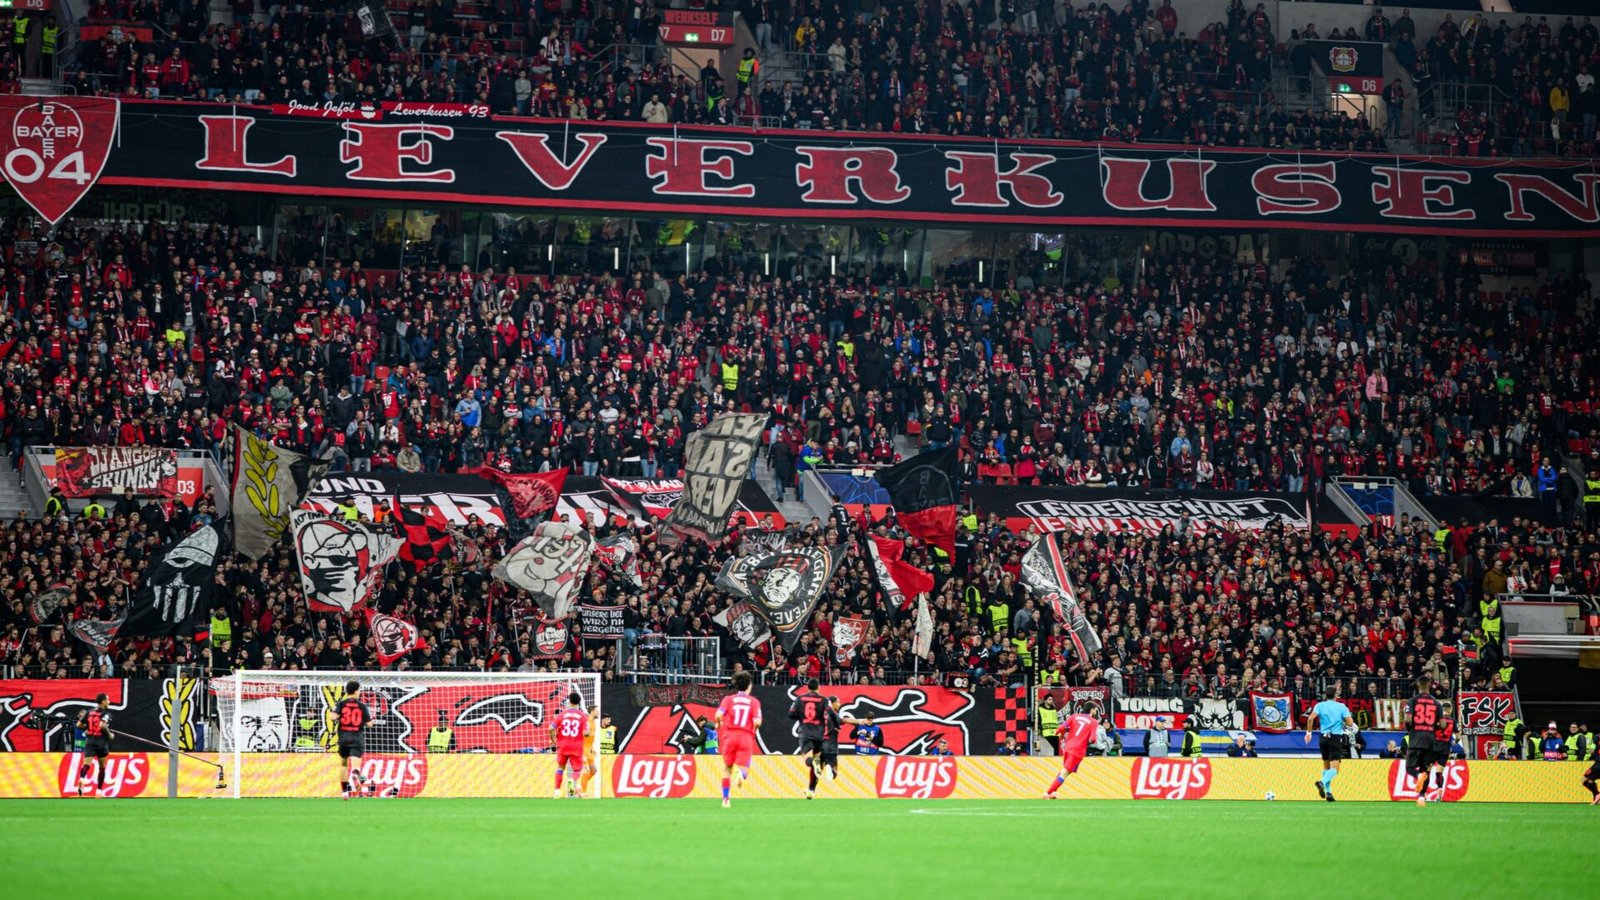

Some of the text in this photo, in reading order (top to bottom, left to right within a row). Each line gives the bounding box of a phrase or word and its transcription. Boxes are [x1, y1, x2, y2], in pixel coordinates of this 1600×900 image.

[711, 29, 726, 42] D7
[1362, 79, 1377, 92] D6
[16, 125, 79, 138] BAYER
[4, 147, 92, 185] 04
[177, 480, 195, 494] D3
[1022, 498, 1271, 518] LEIDENSCHAFT
[804, 701, 816, 720] 6
[1118, 697, 1184, 712] YOUNG
[1413, 703, 1437, 725] 35
[1460, 696, 1510, 728] FSK
[340, 706, 363, 727] 30
[732, 704, 751, 728] 17
[561, 718, 580, 738] 33
[1075, 720, 1087, 736] 7
[616, 755, 692, 797] Lay's
[879, 756, 953, 797] Lay's
[1135, 757, 1207, 800] Lay's
